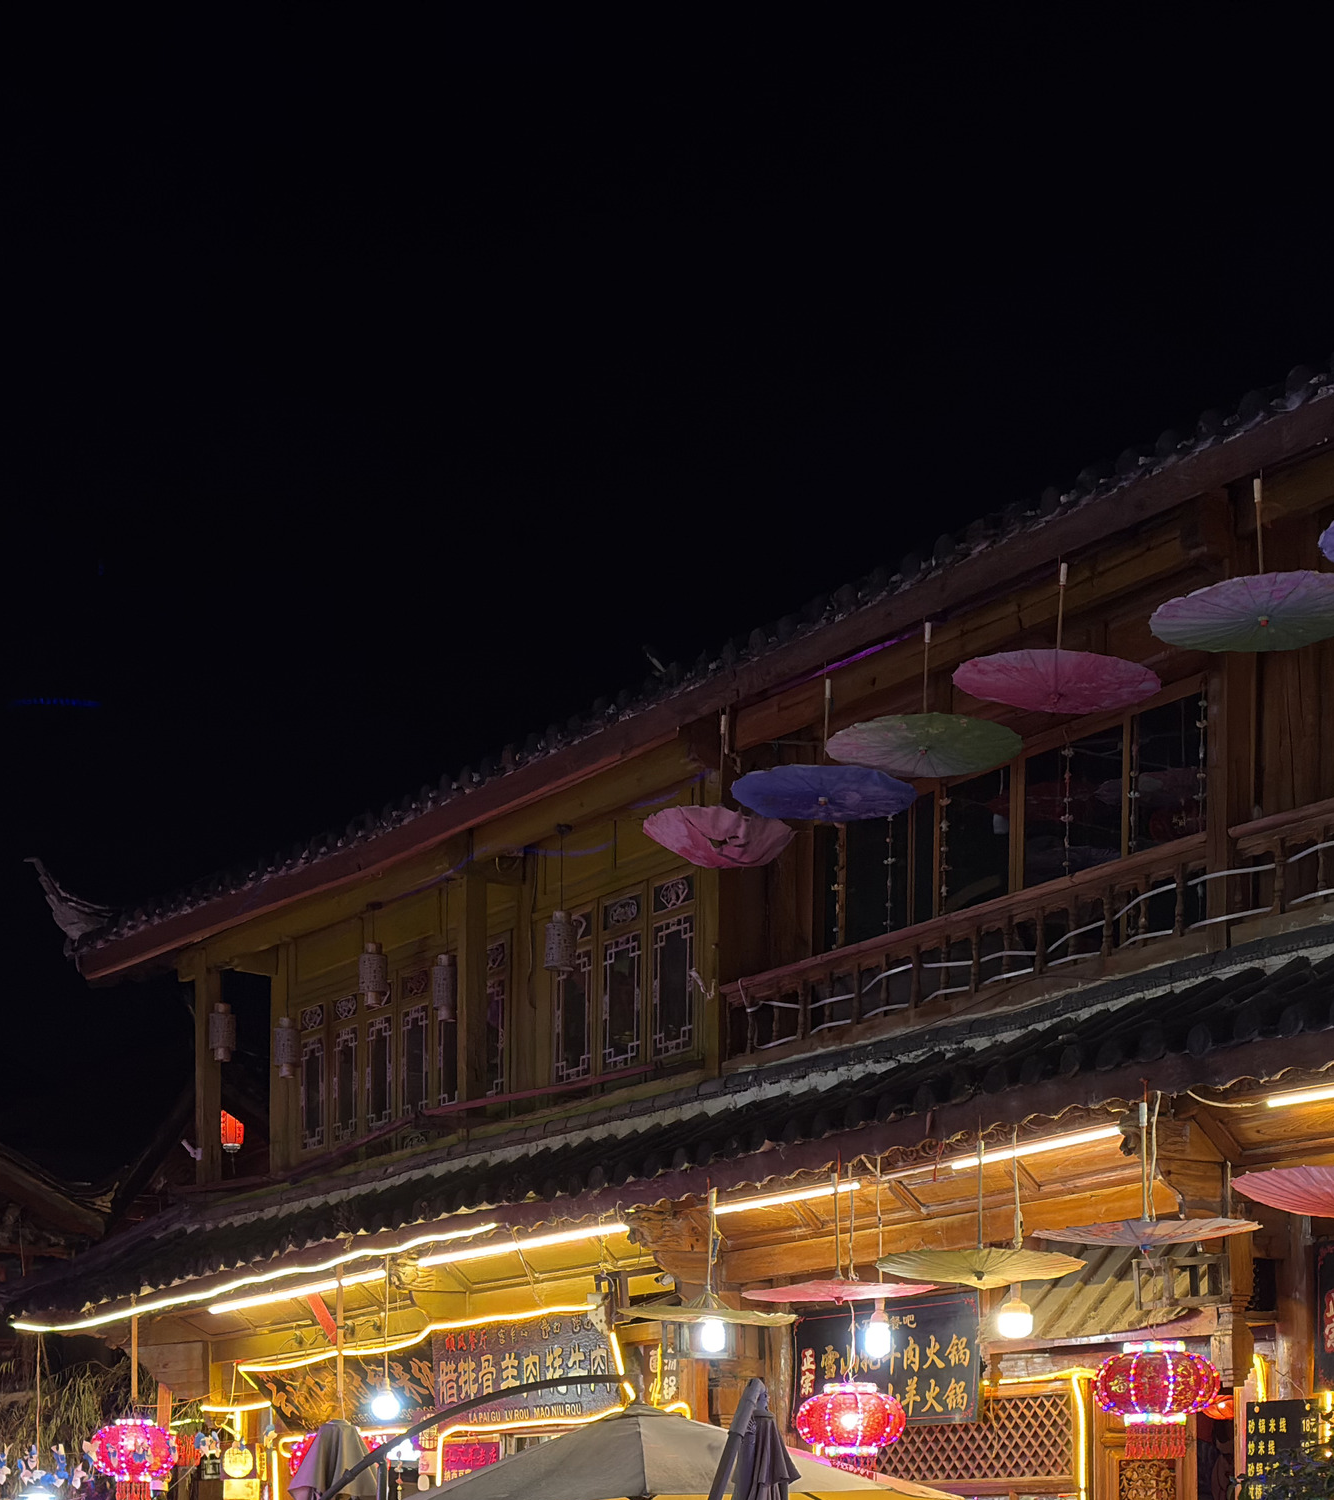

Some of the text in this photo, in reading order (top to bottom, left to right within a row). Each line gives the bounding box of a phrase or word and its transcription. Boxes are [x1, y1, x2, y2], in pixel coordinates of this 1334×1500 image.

[800, 1349, 816, 1396] 正宗
[1248, 1417, 1287, 1434] 砂锅米线
[1248, 1440, 1275, 1456] 炒米线
